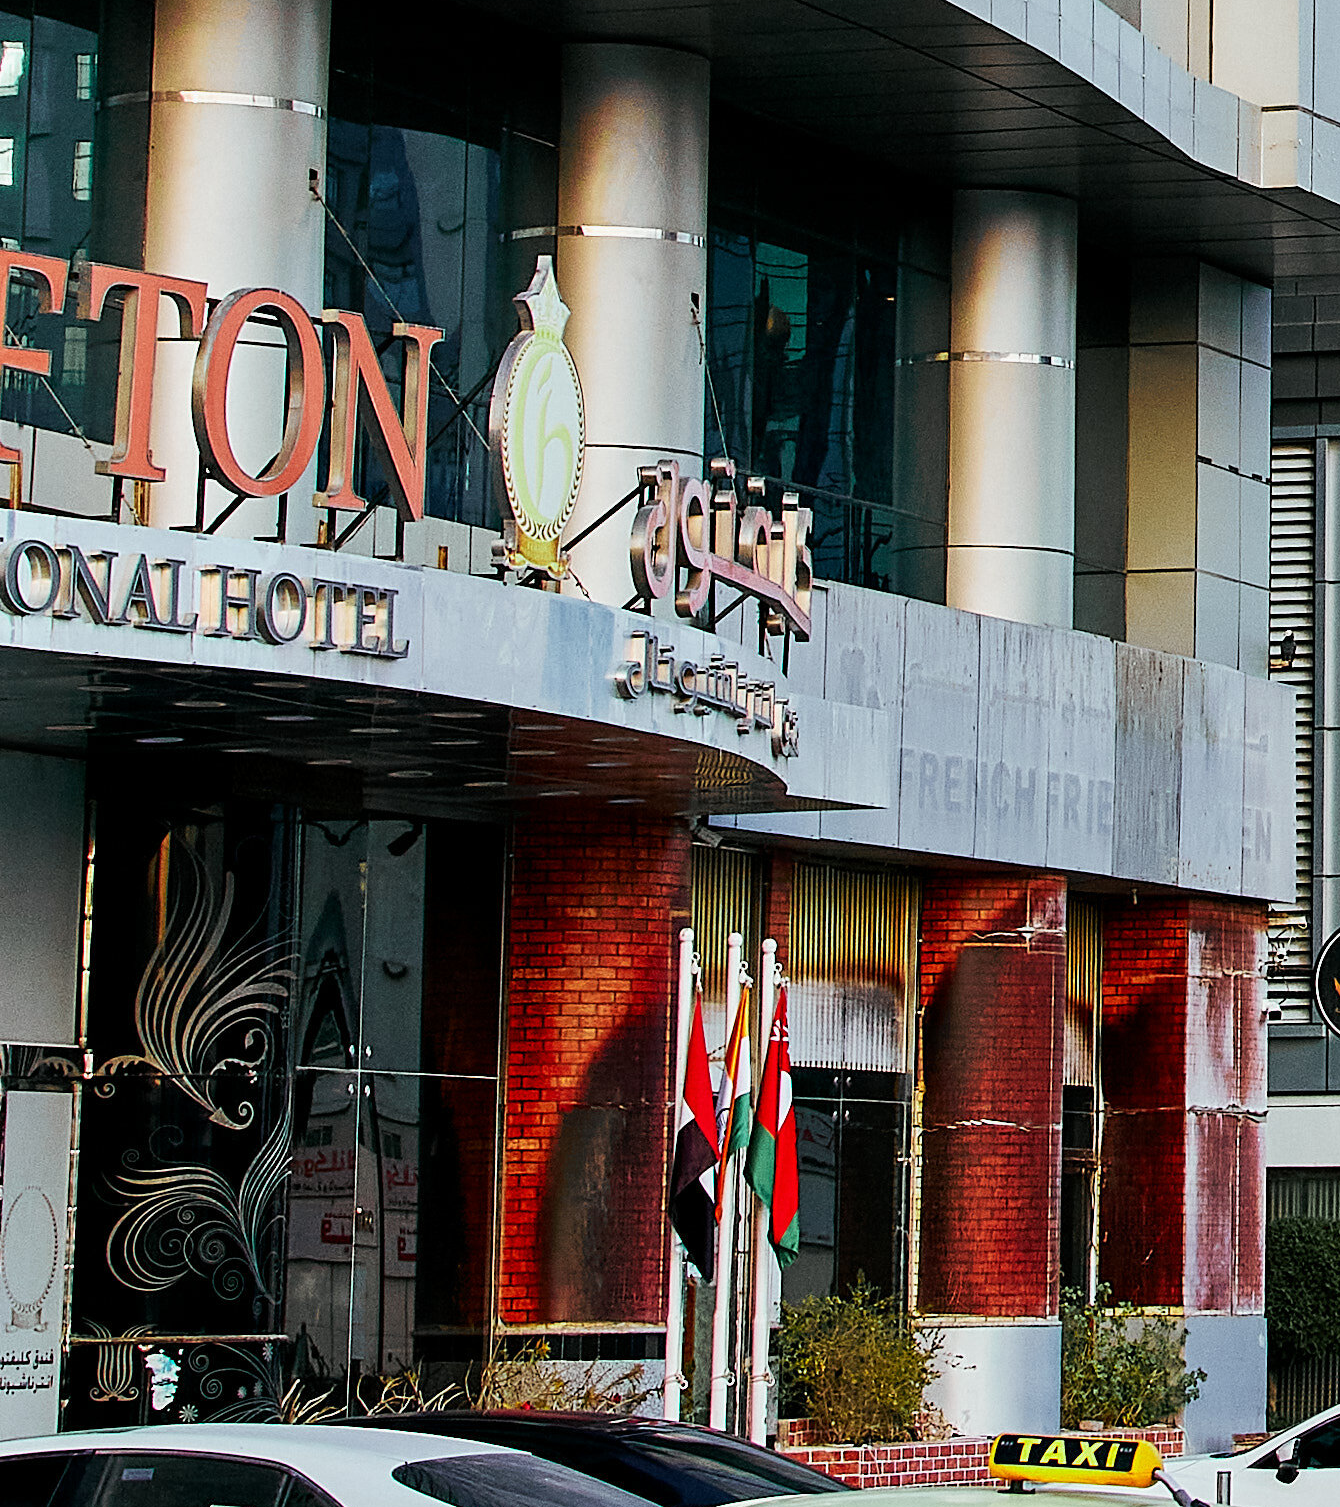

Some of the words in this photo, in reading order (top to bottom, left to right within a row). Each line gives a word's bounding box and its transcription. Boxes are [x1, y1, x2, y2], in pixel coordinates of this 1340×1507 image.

[0, 537, 198, 635] ONAL
[198, 562, 410, 659] HOTEL
[33, 1349, 54, 1369] فندق
[1017, 1437, 1121, 1468] TAXI
